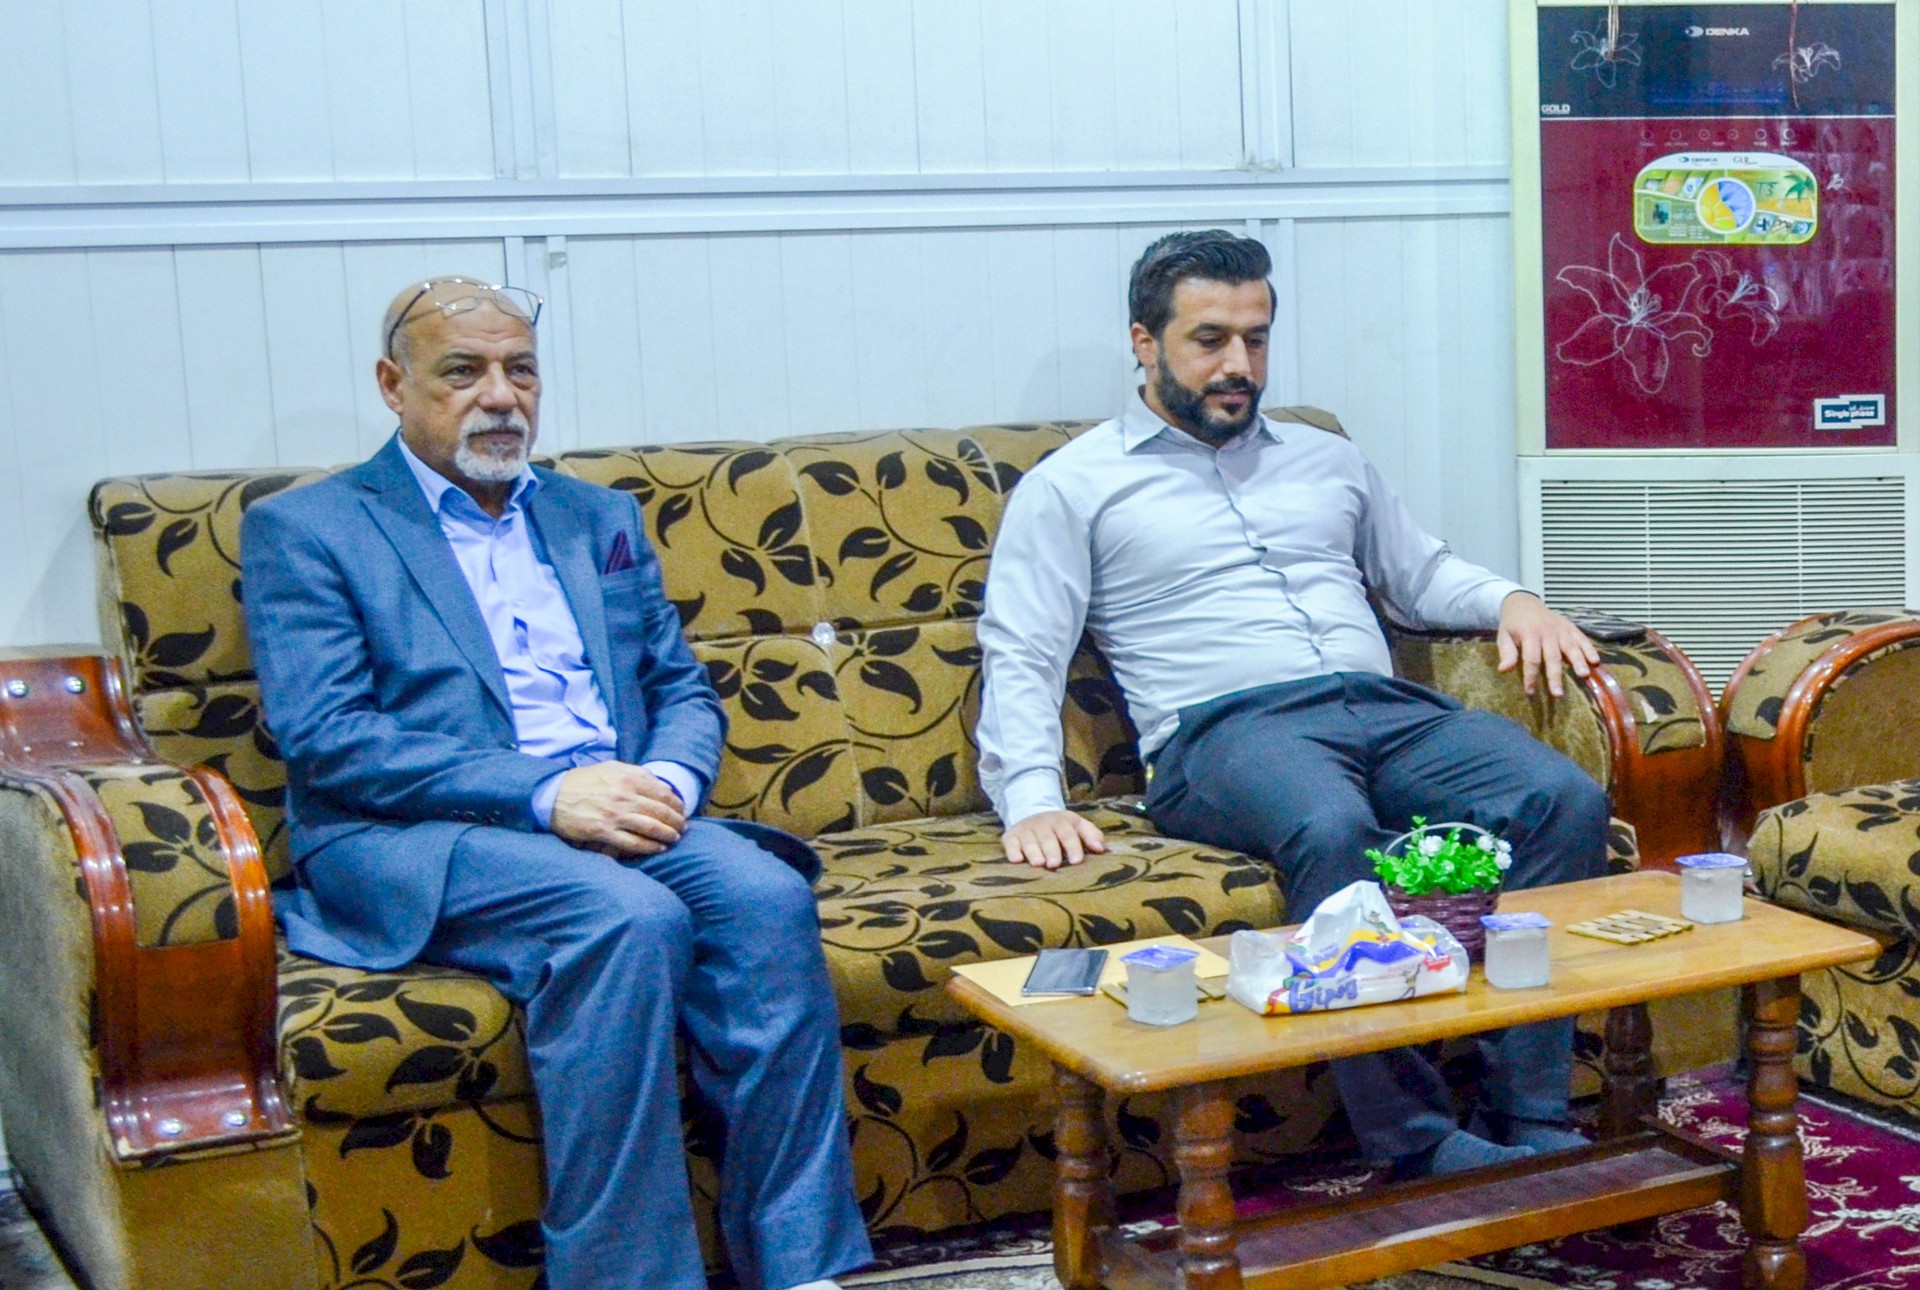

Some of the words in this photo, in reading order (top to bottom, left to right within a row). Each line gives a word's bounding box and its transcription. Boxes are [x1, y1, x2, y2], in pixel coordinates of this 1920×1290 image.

[1705, 27, 1750, 36] DENKA
[1541, 104, 1571, 114] GOLD
[1824, 409, 1850, 419] Single
[1850, 409, 1875, 418] phase
